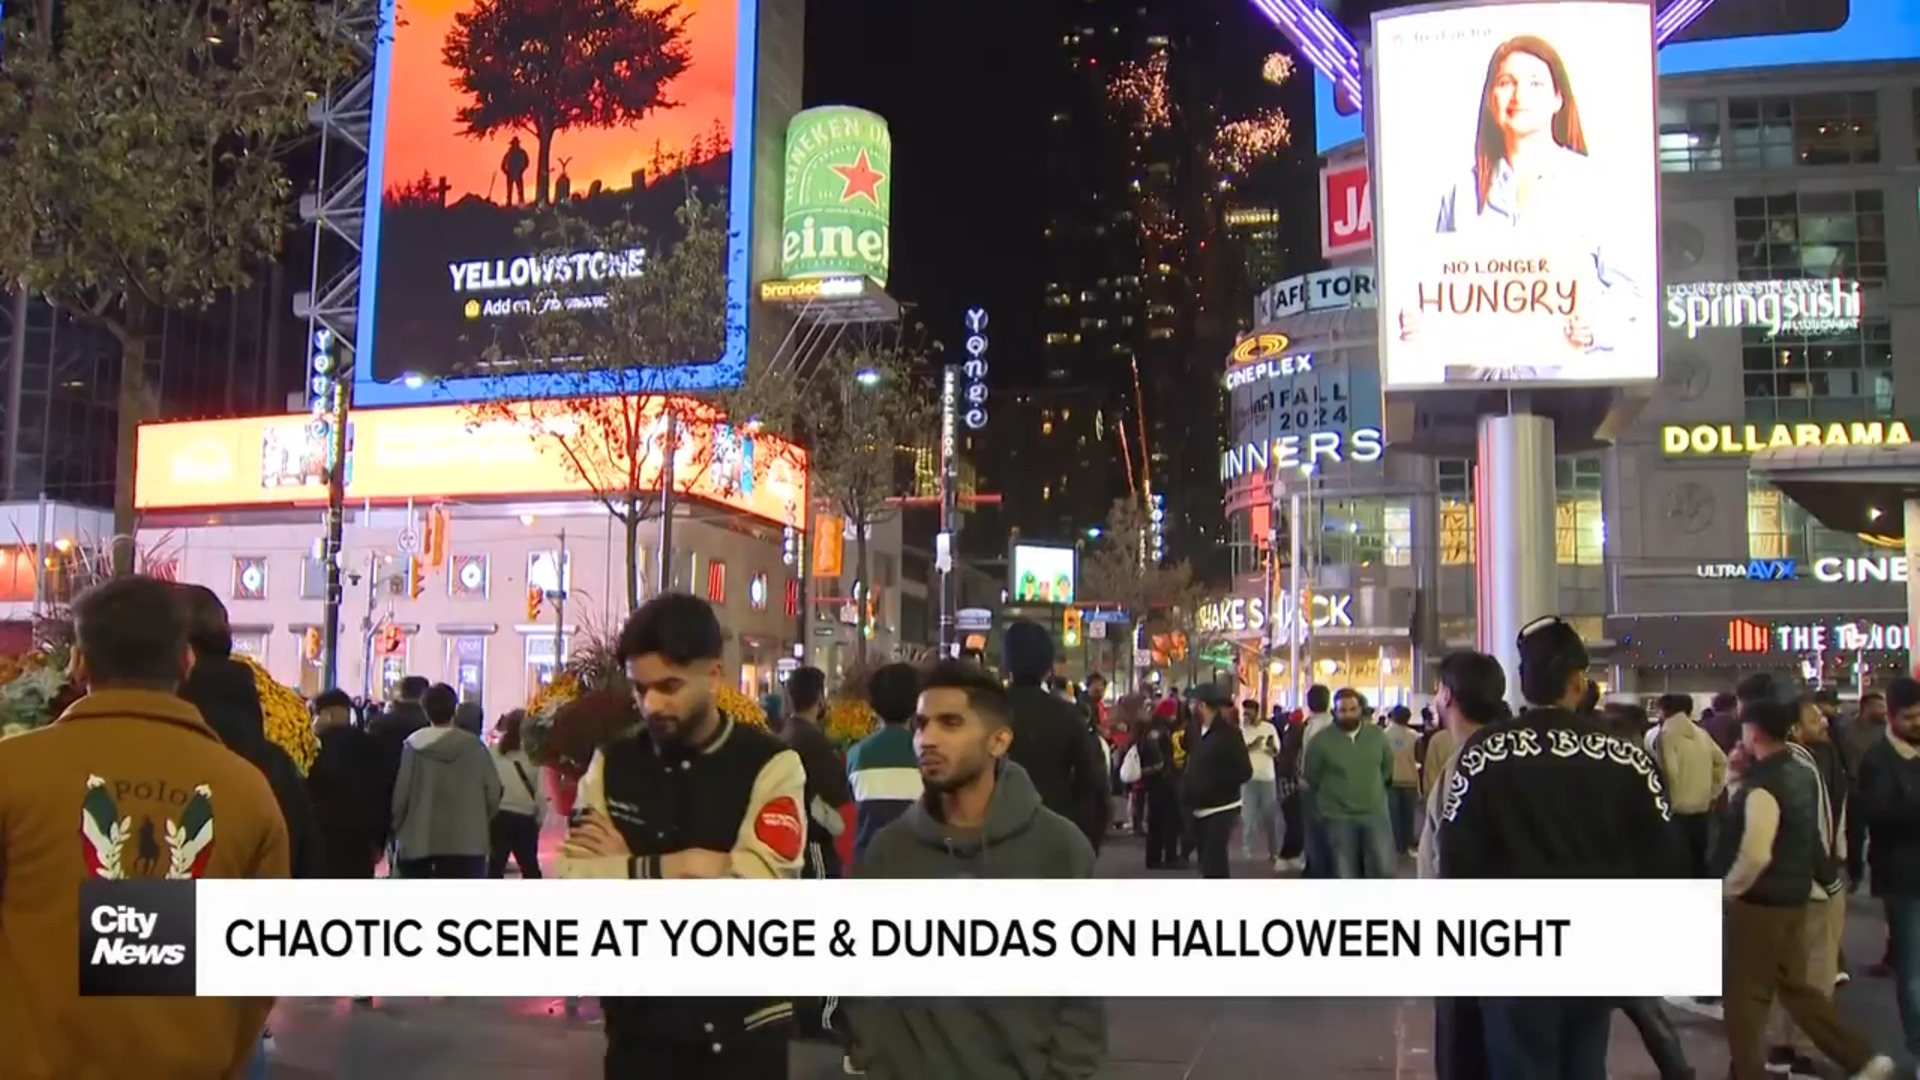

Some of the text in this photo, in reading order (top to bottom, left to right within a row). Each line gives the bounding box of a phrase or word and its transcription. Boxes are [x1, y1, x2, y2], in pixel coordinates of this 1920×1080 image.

[449, 248, 645, 292] YELLOWSTONE
[1443, 259, 1550, 275] NO LONGER
[483, 299, 511, 316] Add
[1417, 279, 1577, 316] HUNGRY
[1226, 353, 1314, 390] CINEPLEX
[1279, 382, 1347, 408] FALL
[1279, 404, 1349, 432] 2024
[1662, 421, 1912, 453] DOLLARAMA
[1220, 427, 1382, 484] INNERS
[1814, 556, 1909, 582] CINE
[1778, 625, 1827, 651] THE
